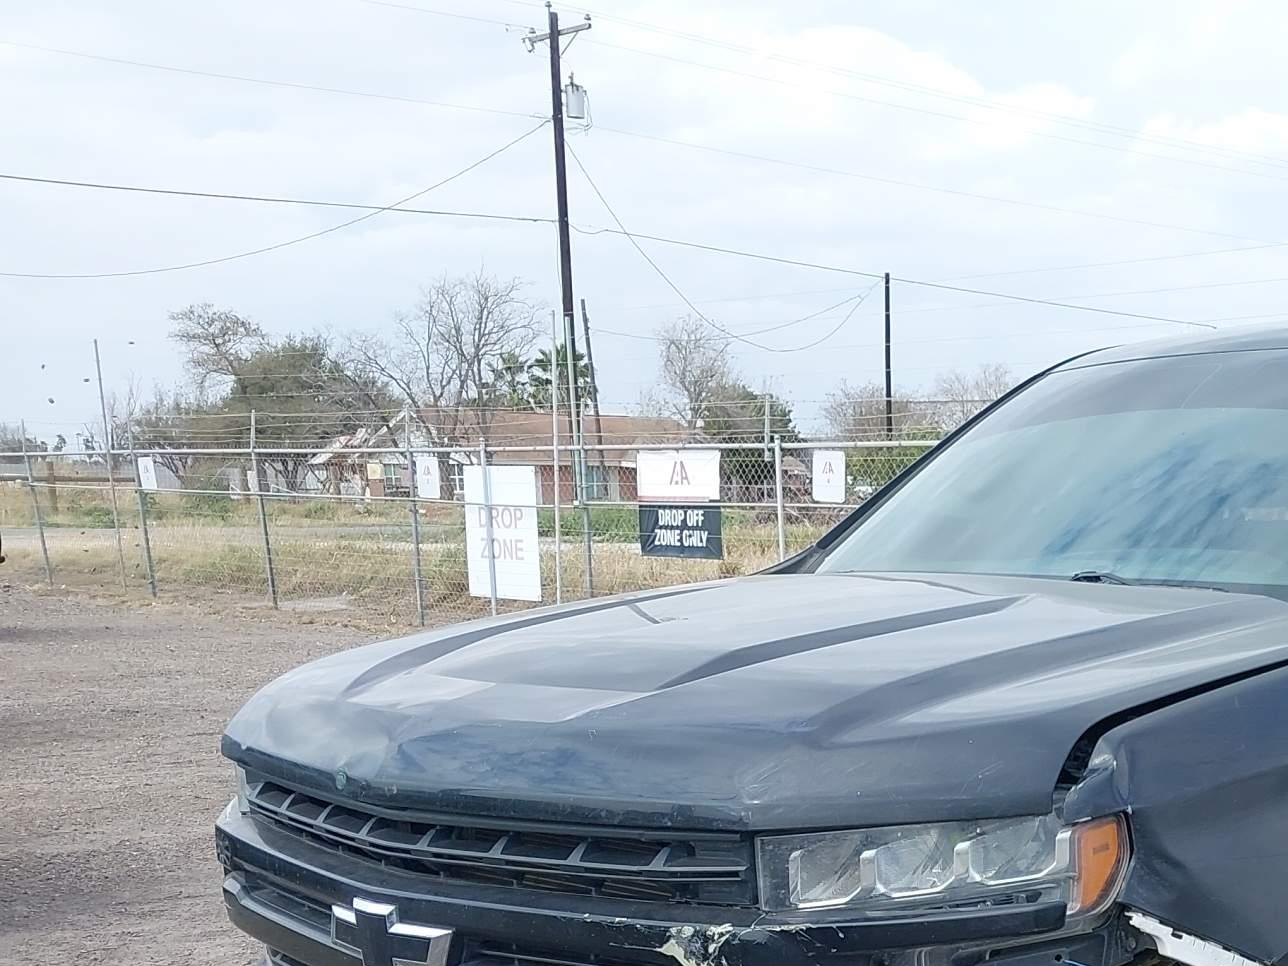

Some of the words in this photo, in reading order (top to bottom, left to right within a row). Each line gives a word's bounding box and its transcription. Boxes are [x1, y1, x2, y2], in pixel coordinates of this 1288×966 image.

[478, 506, 524, 529] DROP
[658, 509, 685, 526] DROP
[686, 510, 705, 527] OFF
[655, 529, 681, 546] ZONE
[682, 530, 708, 547] ONLY
[480, 537, 525, 561] ZONE
